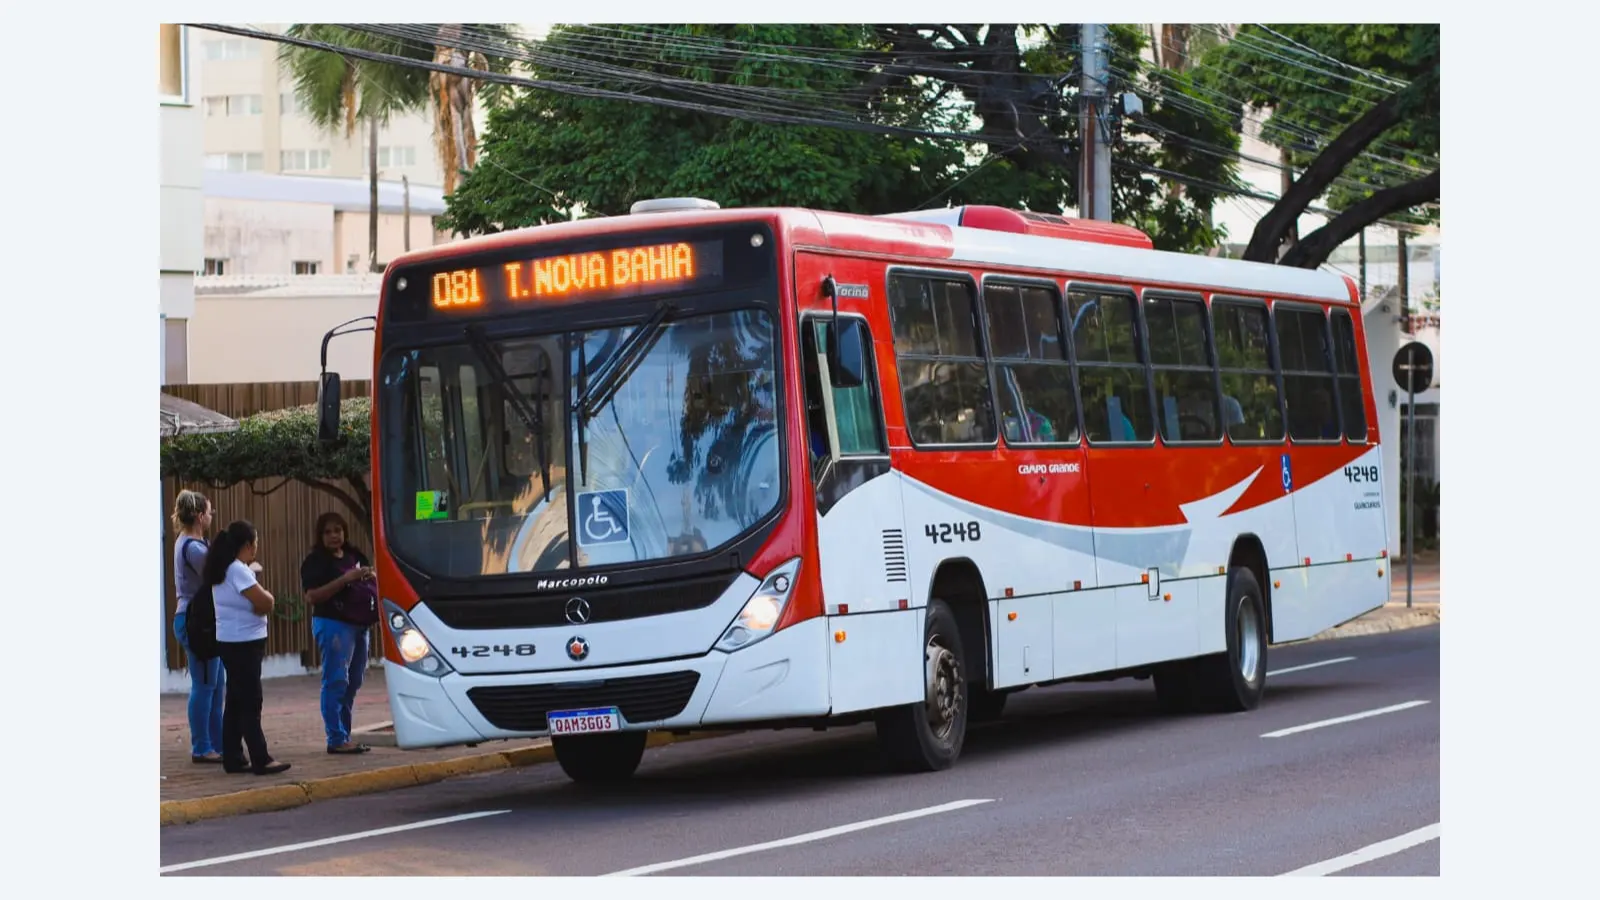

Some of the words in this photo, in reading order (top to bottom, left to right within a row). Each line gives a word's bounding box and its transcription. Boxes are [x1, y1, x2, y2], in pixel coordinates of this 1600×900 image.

[432, 268, 481, 307] 081
[504, 263, 529, 298] T.
[533, 252, 607, 294] NOVA
[612, 242, 693, 285] BAHIA
[1344, 465, 1378, 483] 4248
[925, 521, 981, 544] 4248
[537, 575, 608, 589] Marcopolo
[451, 643, 537, 658] 4248
[555, 715, 612, 732] QAM3G03
